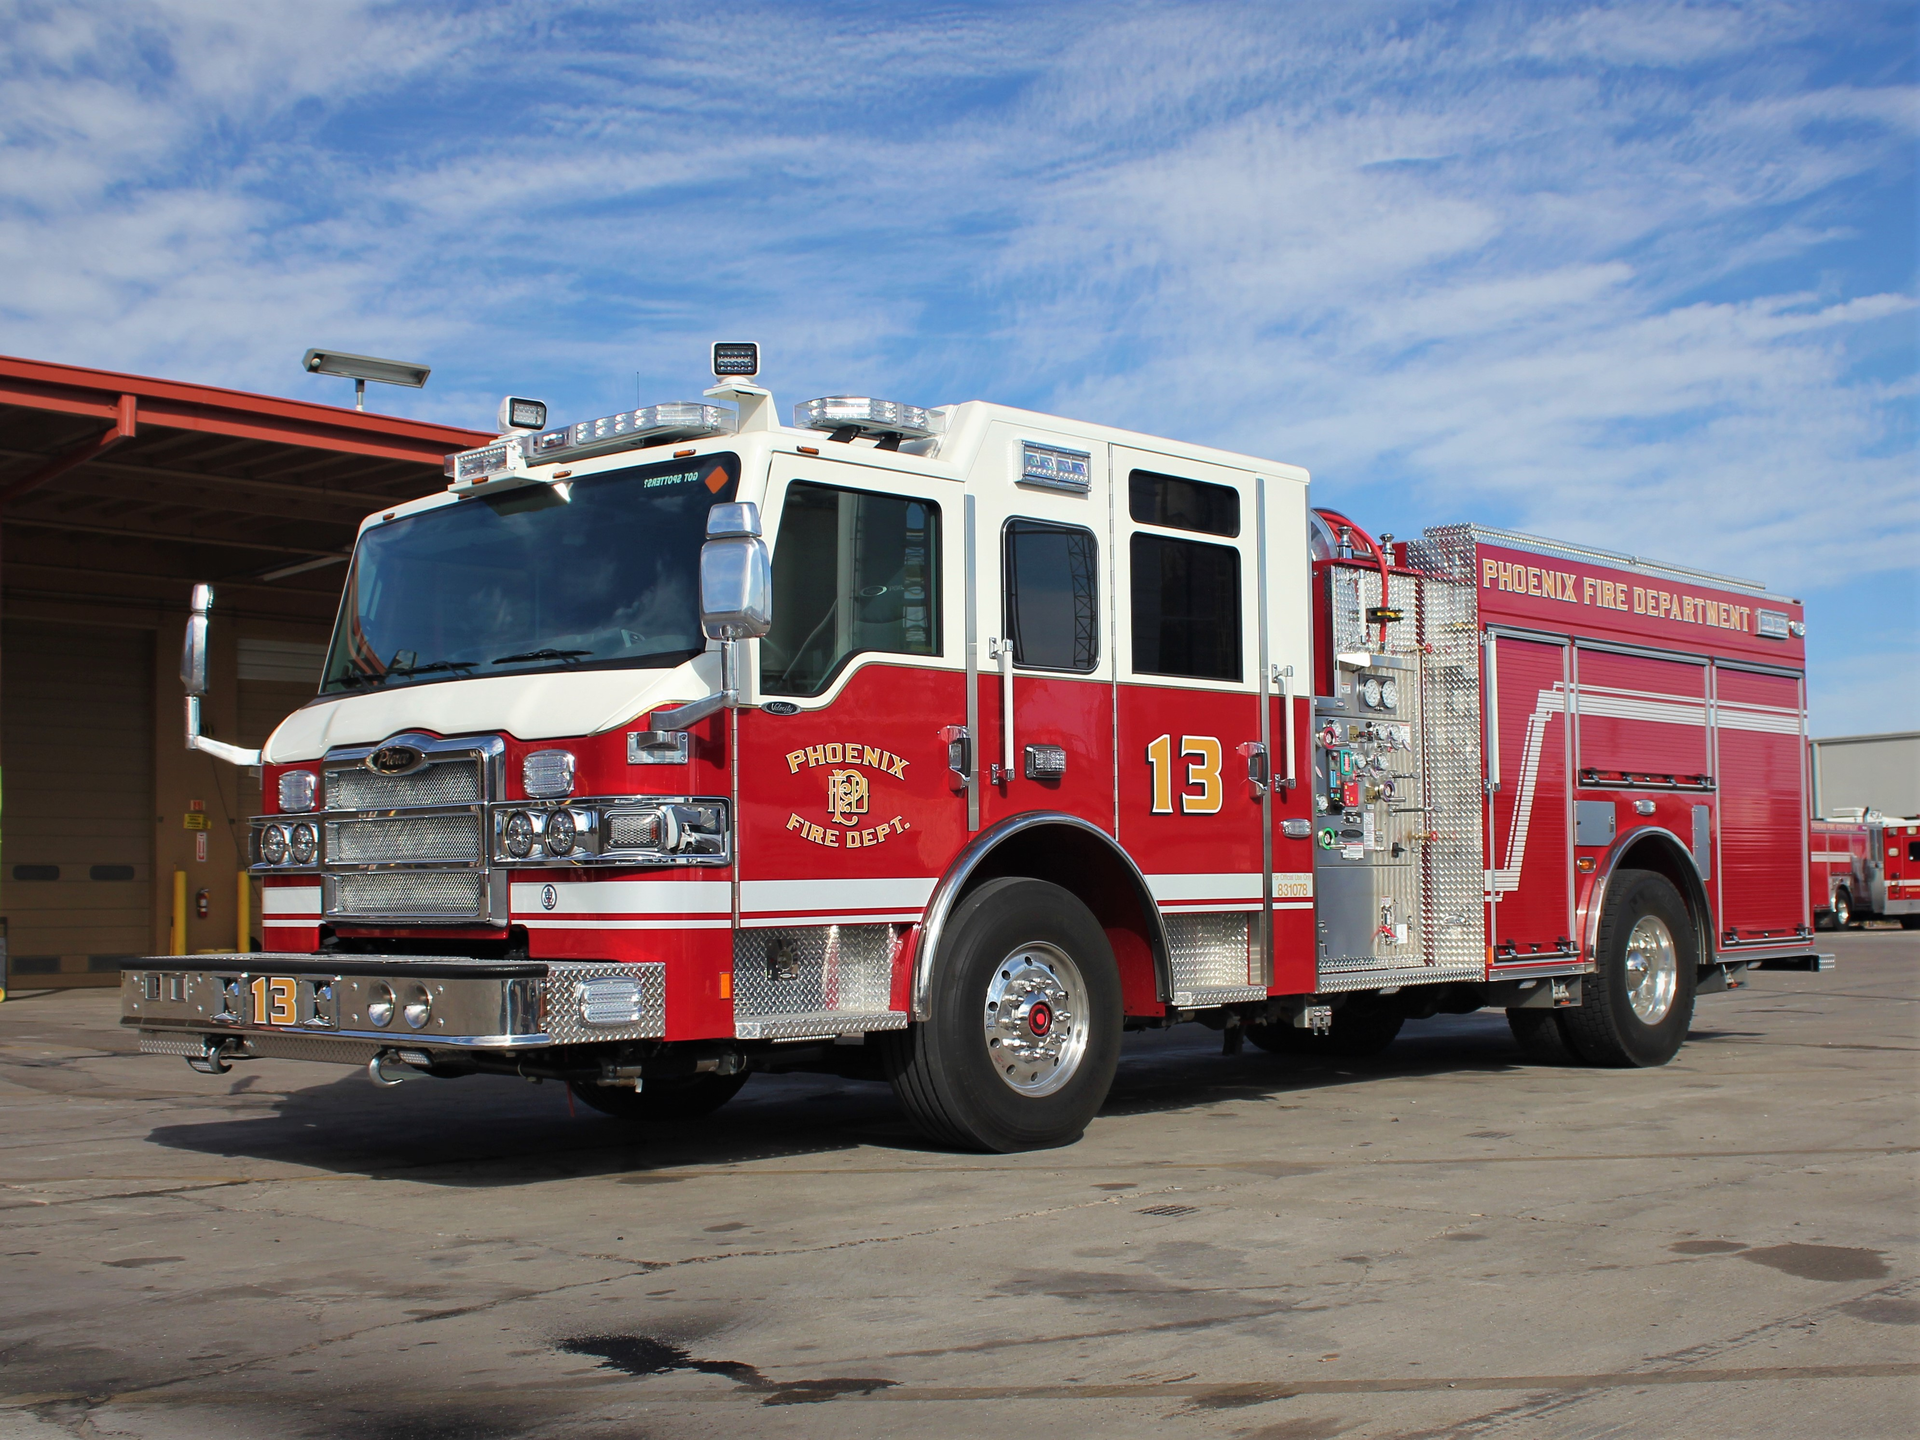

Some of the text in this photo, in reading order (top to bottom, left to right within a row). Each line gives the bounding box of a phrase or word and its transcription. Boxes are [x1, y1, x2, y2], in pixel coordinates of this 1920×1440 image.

[1482, 558, 1751, 632] PHOENIX FIRE DEPARTMENT
[785, 742, 910, 781] PHOENIX
[1145, 733, 1223, 816] 13
[785, 812, 911, 849] FIRE DEPT.
[1277, 883, 1308, 897] 831078
[251, 976, 297, 1026] 13
